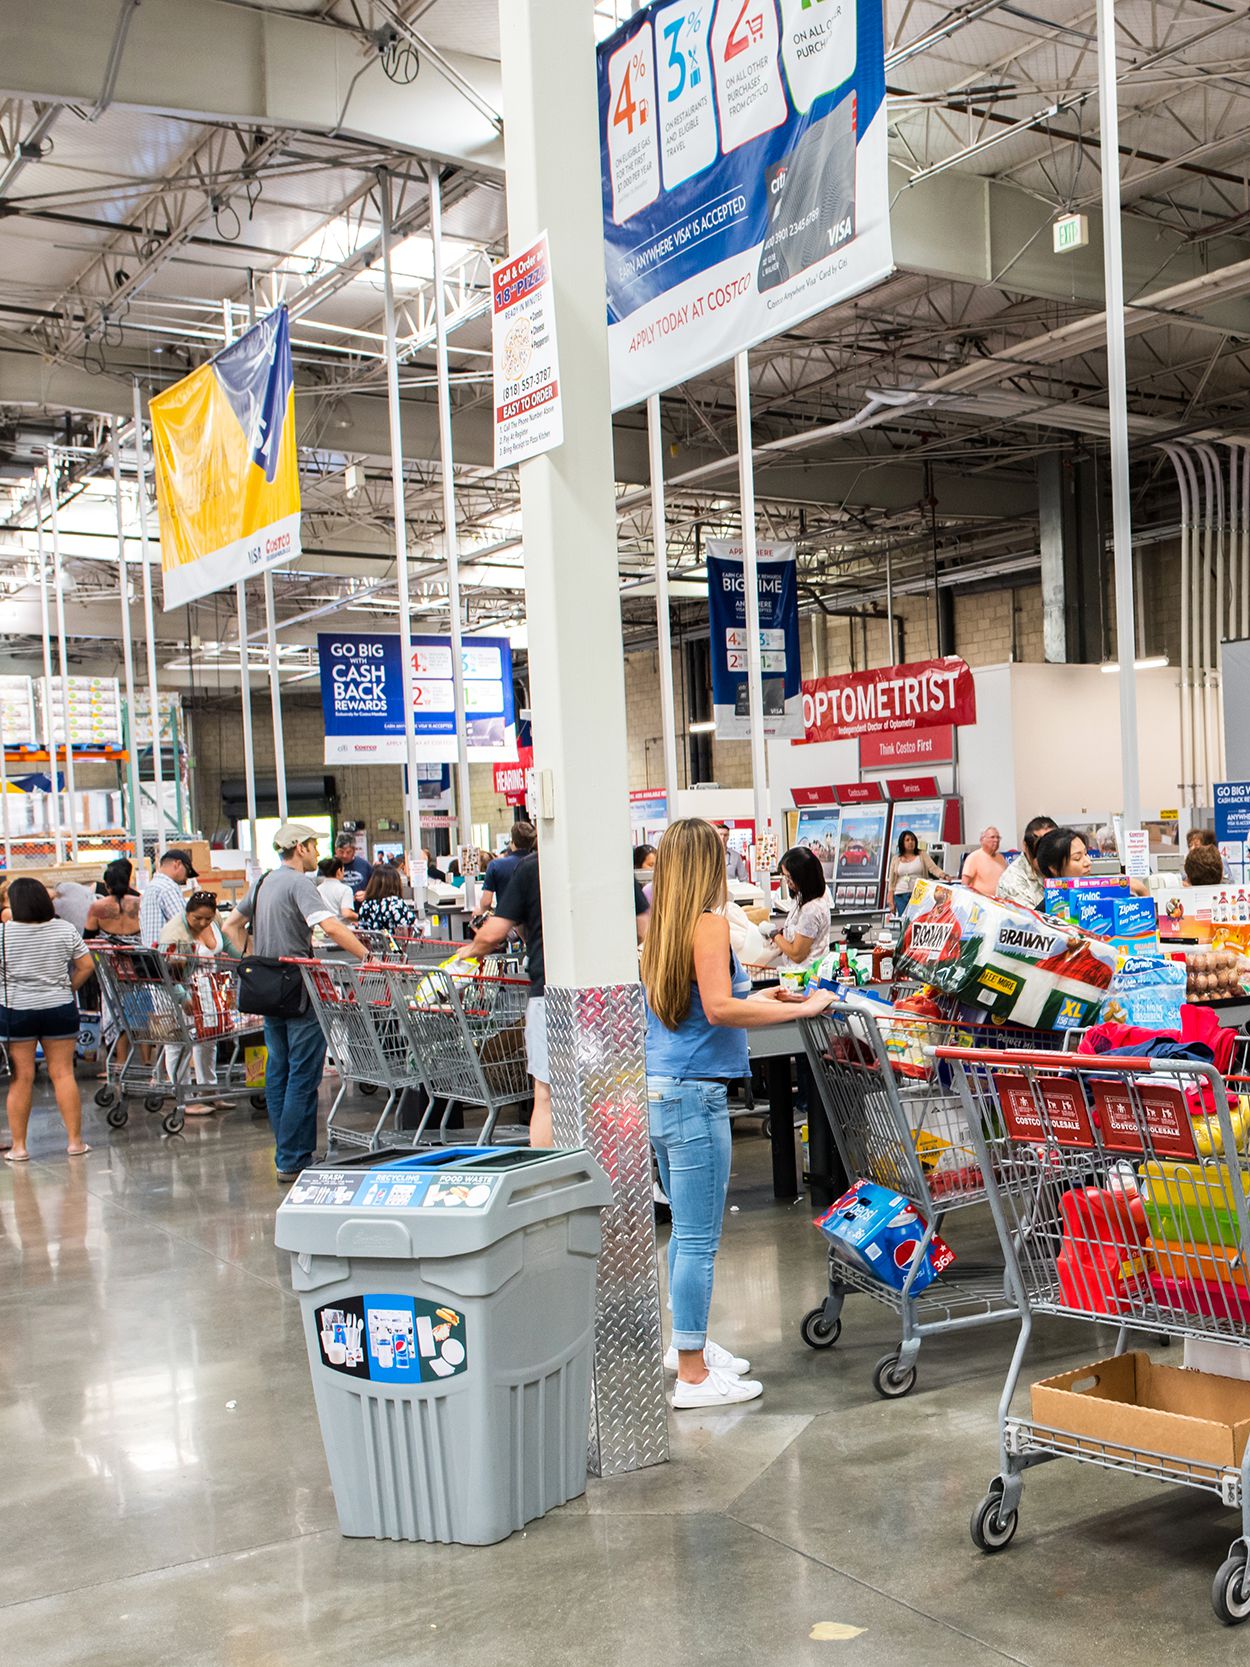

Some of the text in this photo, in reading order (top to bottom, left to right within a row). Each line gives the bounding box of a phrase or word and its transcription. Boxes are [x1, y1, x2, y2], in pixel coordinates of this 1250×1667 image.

[793, 23, 825, 45] ON ALL
[726, 56, 769, 89] ON ALL OTHER
[728, 75, 761, 103] PURCHASES
[665, 96, 708, 133] ON RESTAURANTS
[730, 99, 746, 117] FROM
[666, 116, 699, 145] AND ELIGIBLE
[667, 142, 686, 158] TRAVEL
[618, 195, 747, 282] EARN ANYWHERE IS ACCEPTED
[827, 216, 852, 247] VISA
[1059, 221, 1075, 246] EXIT
[498, 268, 510, 287] Call
[518, 255, 536, 275] Order
[516, 264, 548, 297] PIZZA
[505, 290, 542, 321] READY MINUTES
[629, 272, 751, 352] APPLY TODAY AT COSTCO
[503, 366, 551, 402] (818) 557-3787
[503, 385, 553, 419] EASY TO ORDER
[729, 547, 743, 556] APP
[723, 578, 782, 593] BIG IME
[331, 643, 384, 657] GO BIG
[332, 664, 386, 682] CASH
[334, 682, 387, 700] BACK
[802, 671, 959, 729] OPTOMETRIST
[335, 700, 388, 711] REWARDS
[838, 719, 915, 735] Independent Doctor of Optometry
[880, 739, 932, 755] Think Costco First
[496, 768, 524, 792] HEARING
[903, 784, 920, 793] Services
[1217, 787, 1230, 796] GO
[1231, 786, 1245, 796] BIG
[1047, 889, 1059, 899] Ziploc
[1080, 904, 1097, 920] Ziploc
[1119, 903, 1139, 915] Ziploc
[1129, 914, 1140, 922] Open
[1140, 910, 1151, 918] Tabs
[1000, 929, 1056, 952] BRAWNY
[1125, 959, 1153, 972] Charmin
[998, 976, 1014, 991] MORE
[1061, 1000, 1082, 1018] XL
[1057, 1016, 1068, 1026] 156
[1016, 1117, 1041, 1127] COSTCO
[1111, 1122, 1138, 1132] COSTCO
[376, 1174, 420, 1182] RECYCLING
[439, 1175, 463, 1183] FOOD
[465, 1175, 494, 1184] WASTE
[853, 1203, 879, 1222] pepsi
[933, 1254, 950, 1272] 36
